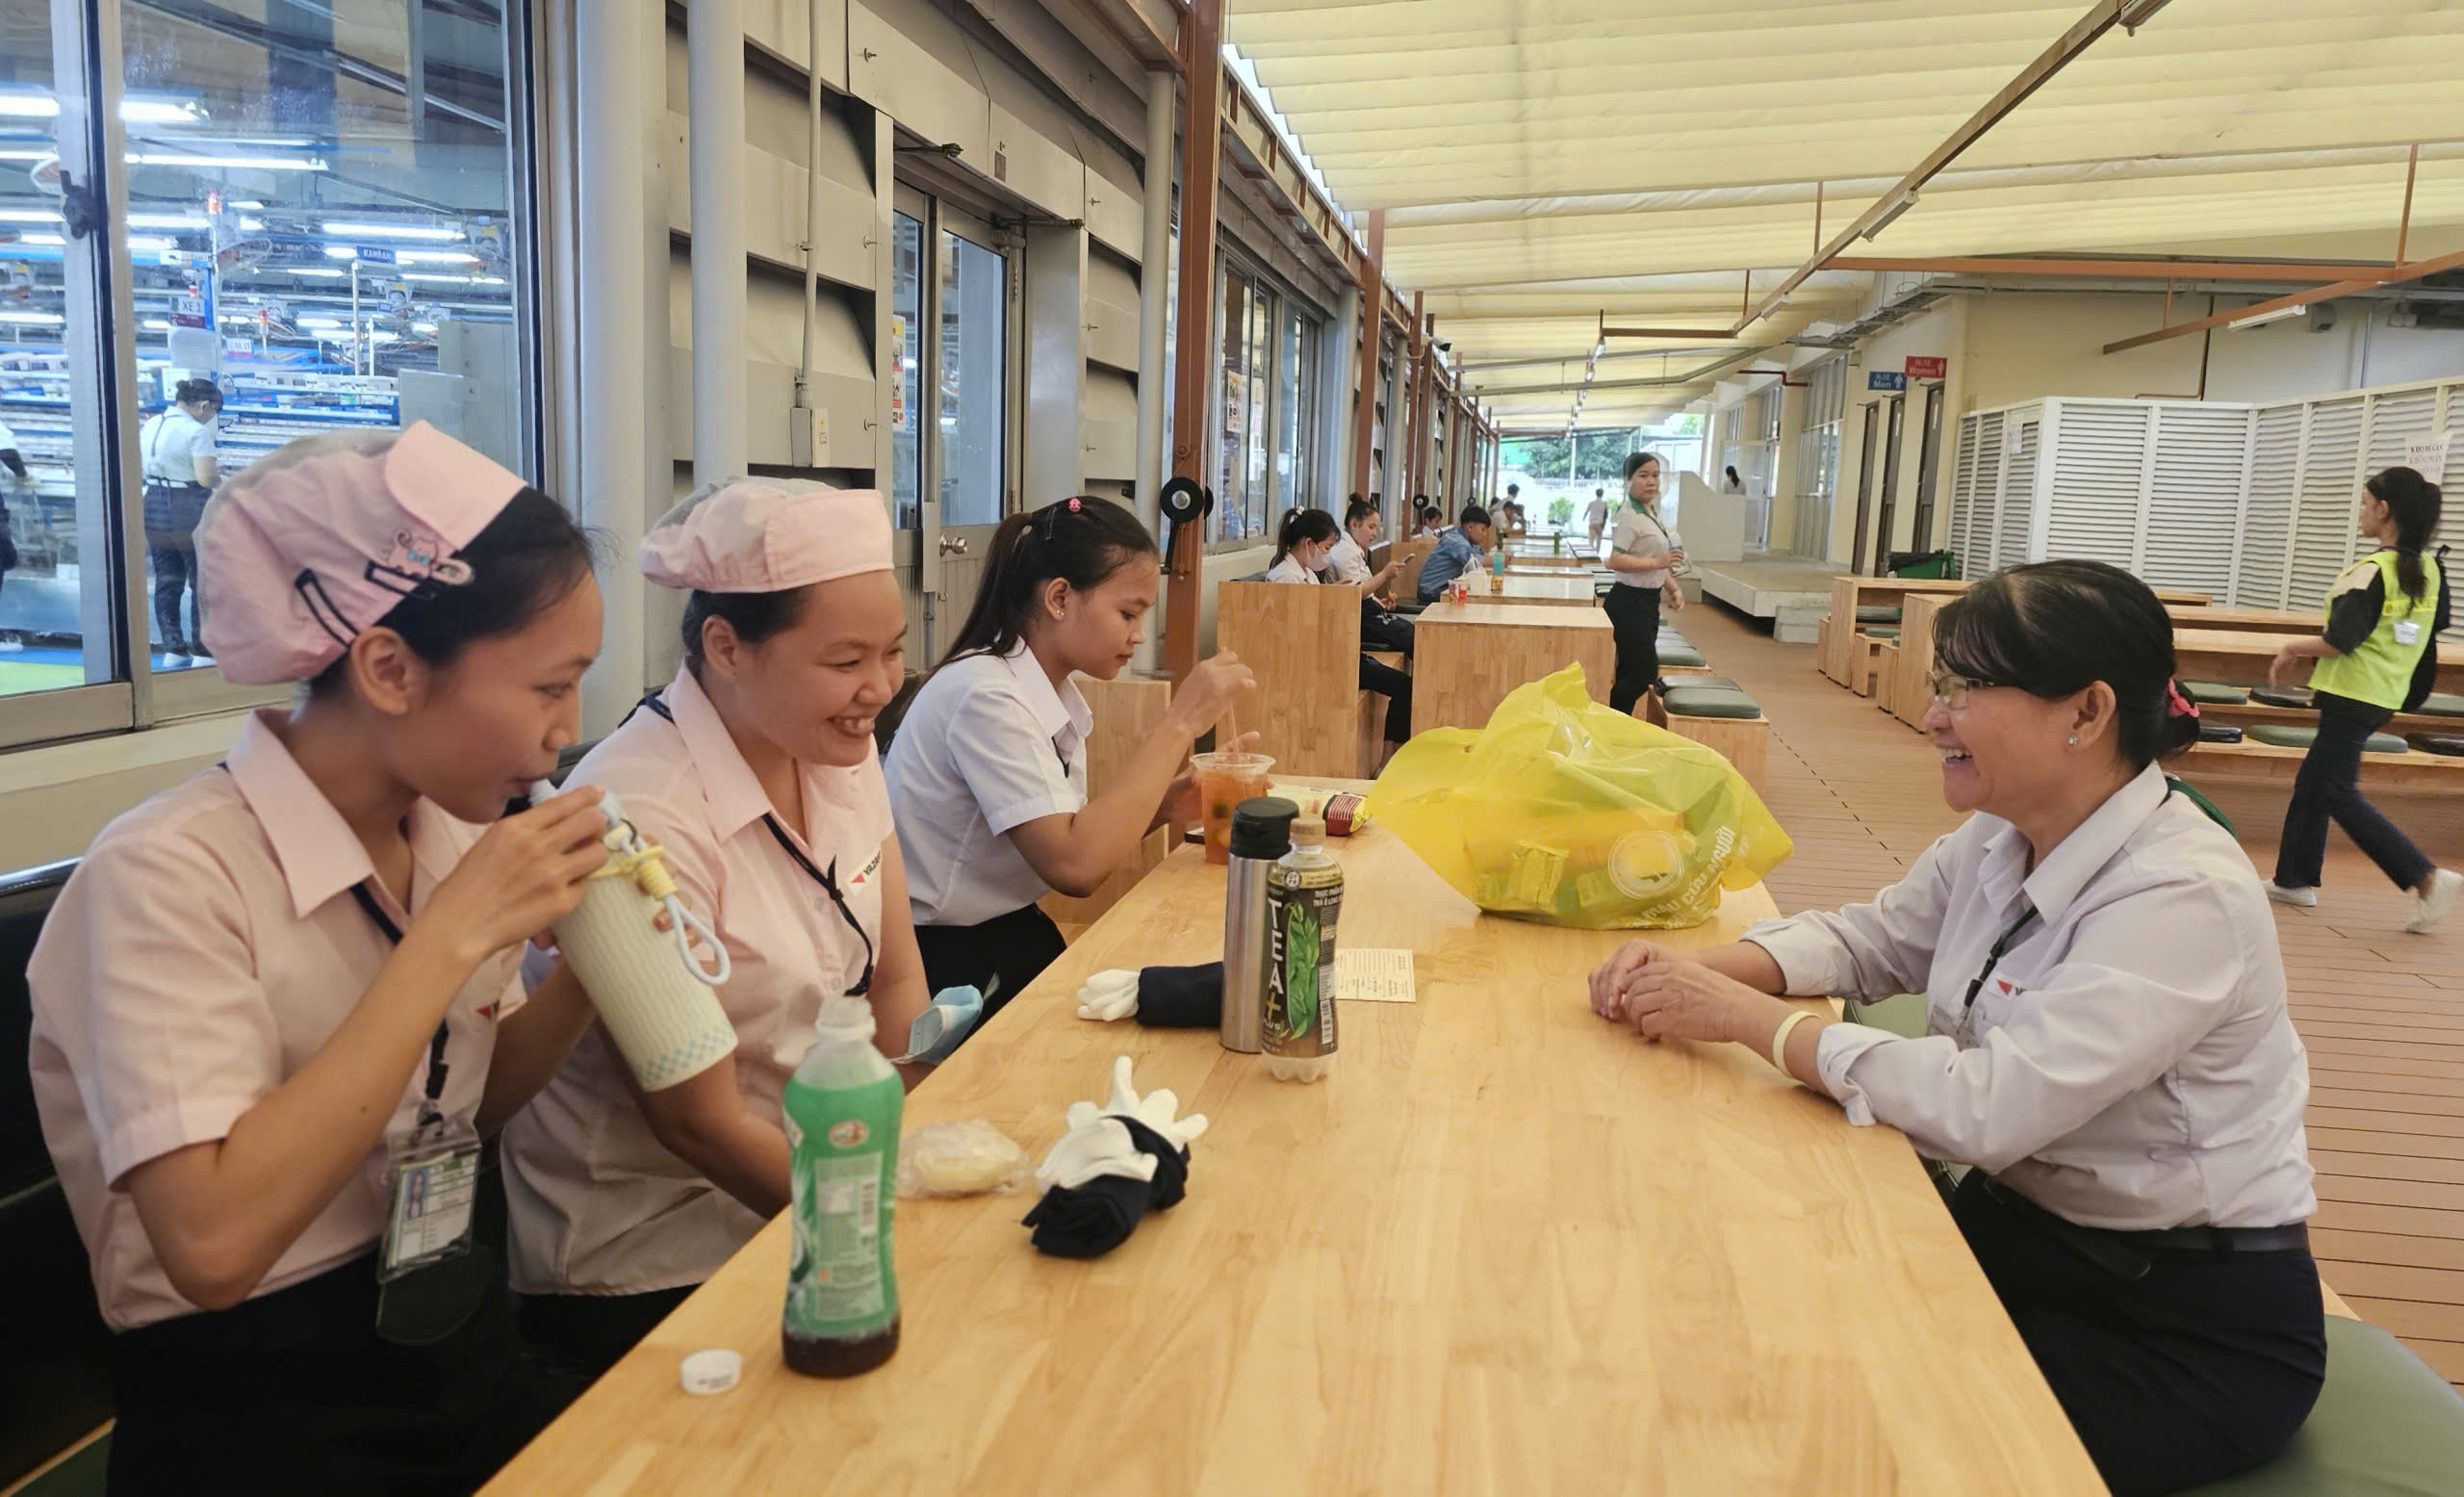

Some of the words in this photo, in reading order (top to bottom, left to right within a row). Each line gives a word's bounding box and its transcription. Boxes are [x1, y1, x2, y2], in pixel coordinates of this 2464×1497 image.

[183, 300, 194, 312] XE
[1909, 366, 1937, 375] Women
[1873, 379, 1891, 389] Men
